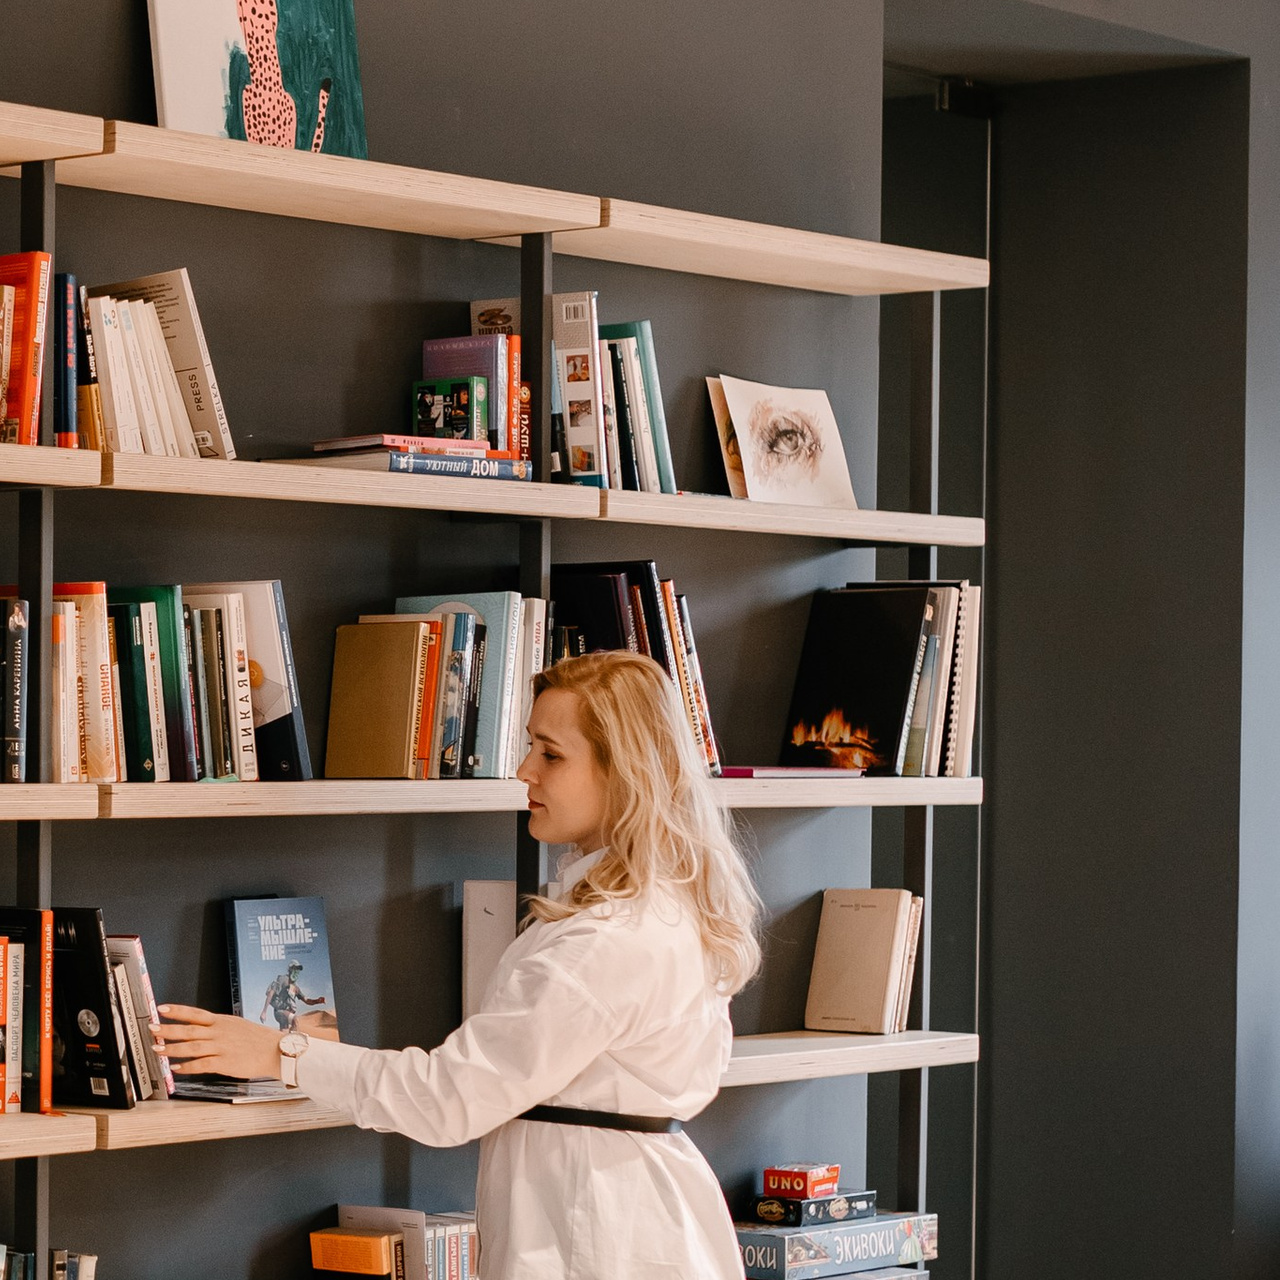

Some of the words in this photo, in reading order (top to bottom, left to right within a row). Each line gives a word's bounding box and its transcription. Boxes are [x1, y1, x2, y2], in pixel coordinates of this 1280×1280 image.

[86, 334, 98, 378] НЬЮ-ЙОРК
[189, 373, 205, 412] PRESS
[211, 382, 229, 435] STRELKA
[425, 458, 468, 473] УЮТНЫЙ
[471, 460, 499, 477] ДОМ
[508, 601, 520, 665] ПОЛЮБИТЬ
[14, 639, 23, 695] КАРЕНИНА
[533, 647, 541, 672] себе
[100, 663, 111, 712] CHARGE
[413, 686, 423, 745] ПРАКТИЧЕСКОЙ
[418, 634, 429, 686] ПСИХОЛОГИИ
[13, 698, 21, 730] АННА
[236, 678, 255, 754] ДИКАЯ
[44, 923, 53, 952] ДЕЛАЙ!
[258, 914, 310, 931] УЛЬТРА-
[260, 928, 318, 946] МЫШЛЕ-
[10, 954, 20, 977] МИРА
[261, 945, 286, 961] НИЕ
[10, 979, 20, 1023] ЧЕЛОВЕКА
[10, 1025, 20, 1062] ПАСПОРТ
[769, 1176, 804, 1191] UNO
[395, 1244, 404, 1276] ДАРВИН
[450, 1236, 458, 1276] АЛИГЬЕРИ
[833, 1229, 896, 1265] ЭКИВОКИ
